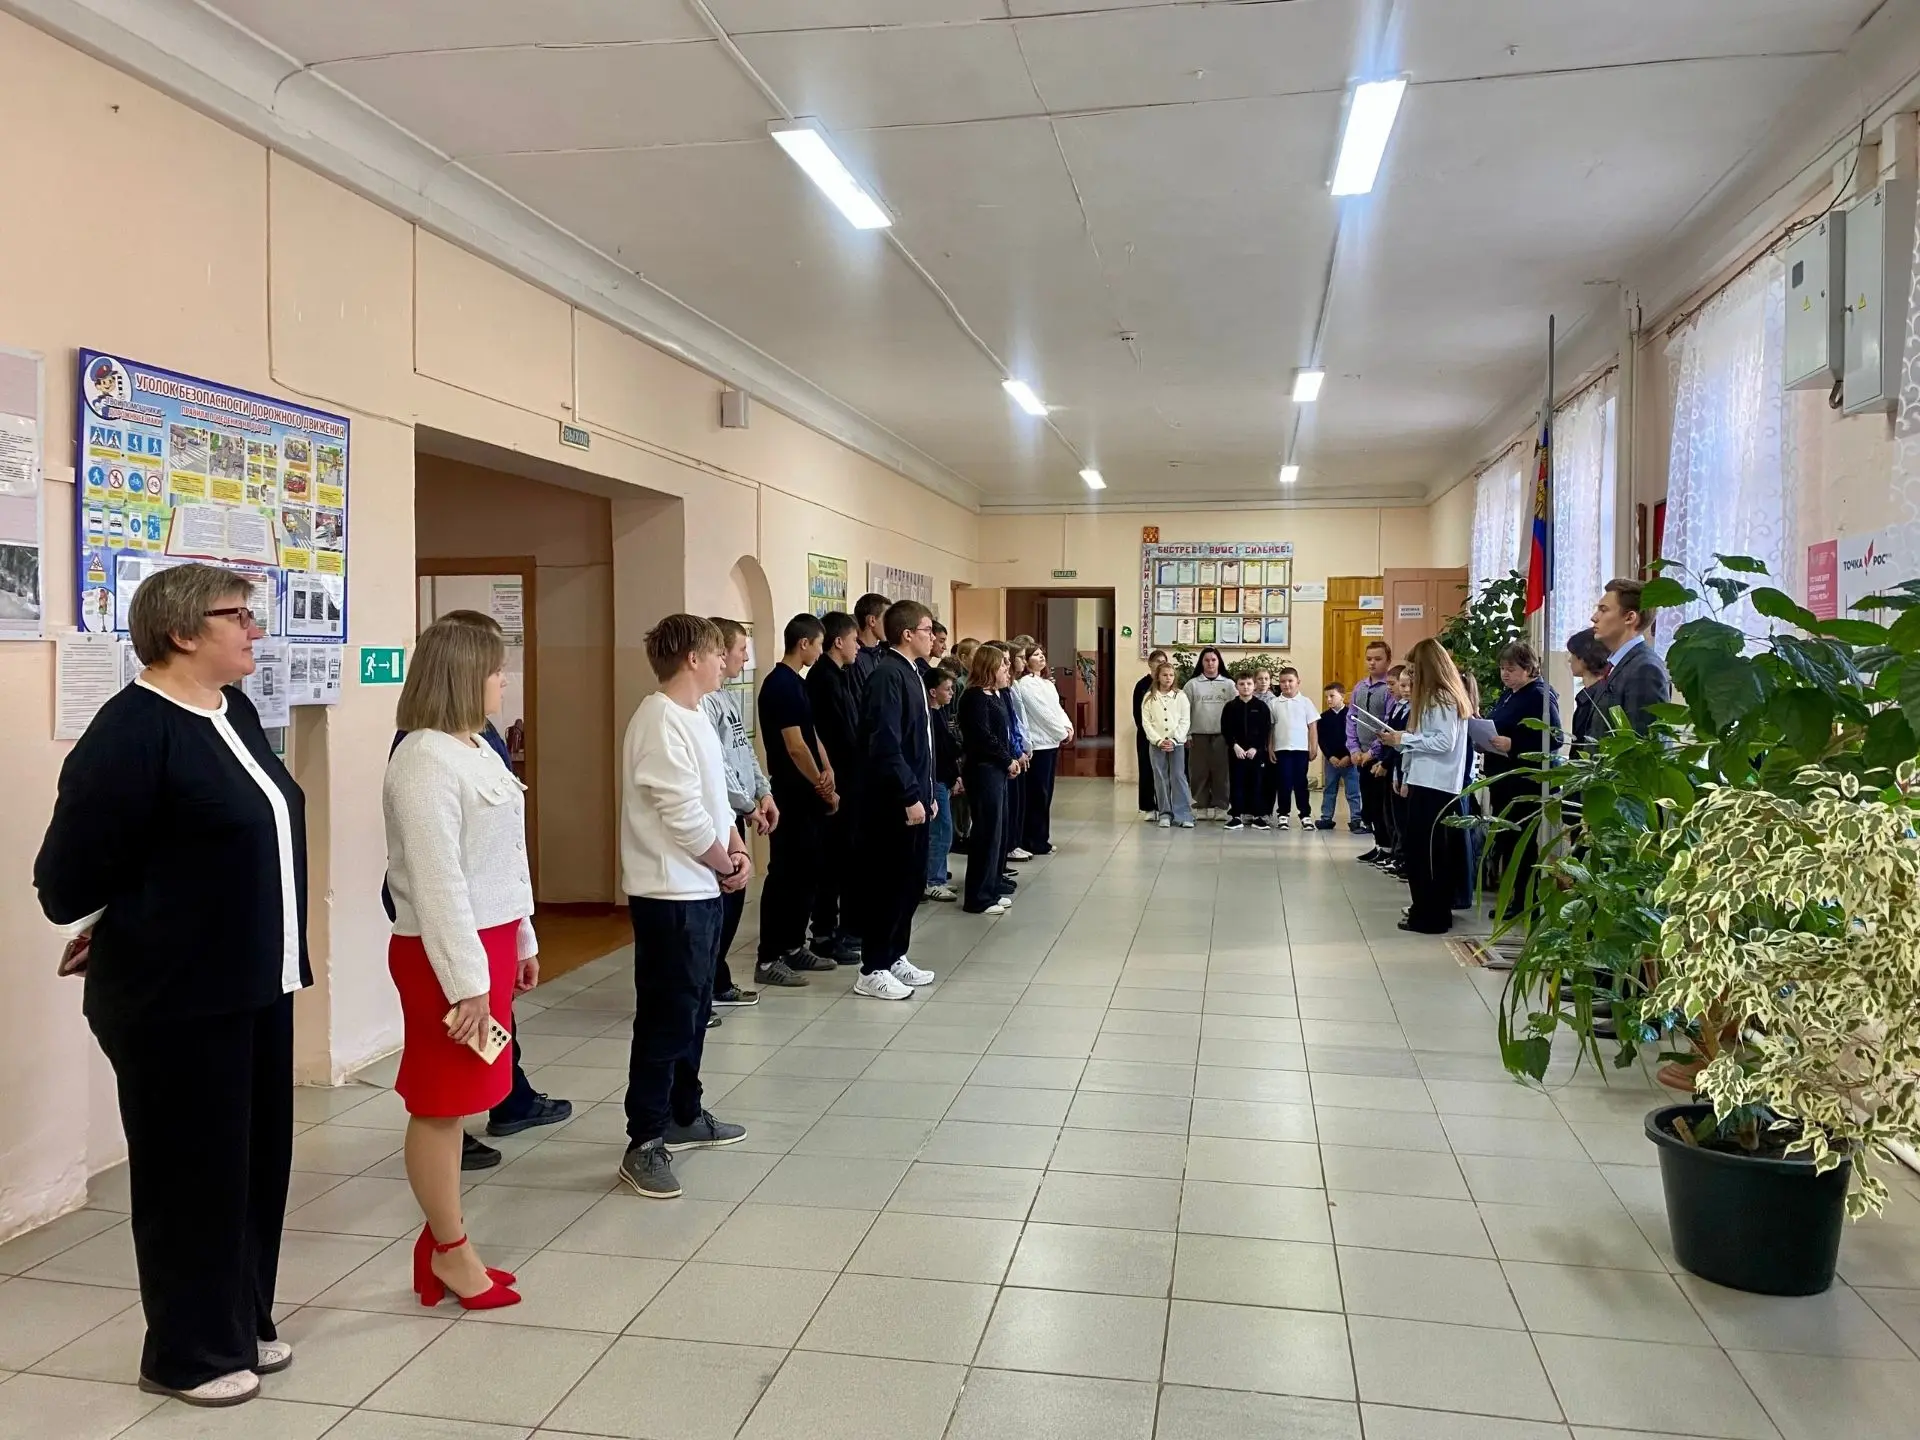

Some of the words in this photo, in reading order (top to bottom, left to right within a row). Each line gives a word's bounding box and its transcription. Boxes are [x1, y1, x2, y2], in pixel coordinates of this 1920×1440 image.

[136, 374, 178, 397] УГОЛОК
[179, 385, 249, 414] БЕЗОПАСНОСТИ
[251, 403, 301, 428] ДОРОЖНОГО
[303, 416, 344, 438] ДВИЖЕНИЯ
[181, 406, 208, 419] ПРАВИЛА
[209, 412, 241, 428] ПОВЕДЕНИЯ
[565, 428, 588, 447] ВЫХОД
[1158, 546, 1201, 554] БЫСТРЕЕ!
[1209, 546, 1238, 554] ВЫШЕ!
[1245, 545, 1290, 554] СИЛЬНЕЕ!
[1843, 559, 1863, 571] ТОЧКА
[1873, 553, 1891, 566] РОС
[1142, 584, 1150, 657] ДОСТИЖЕНИЯ
